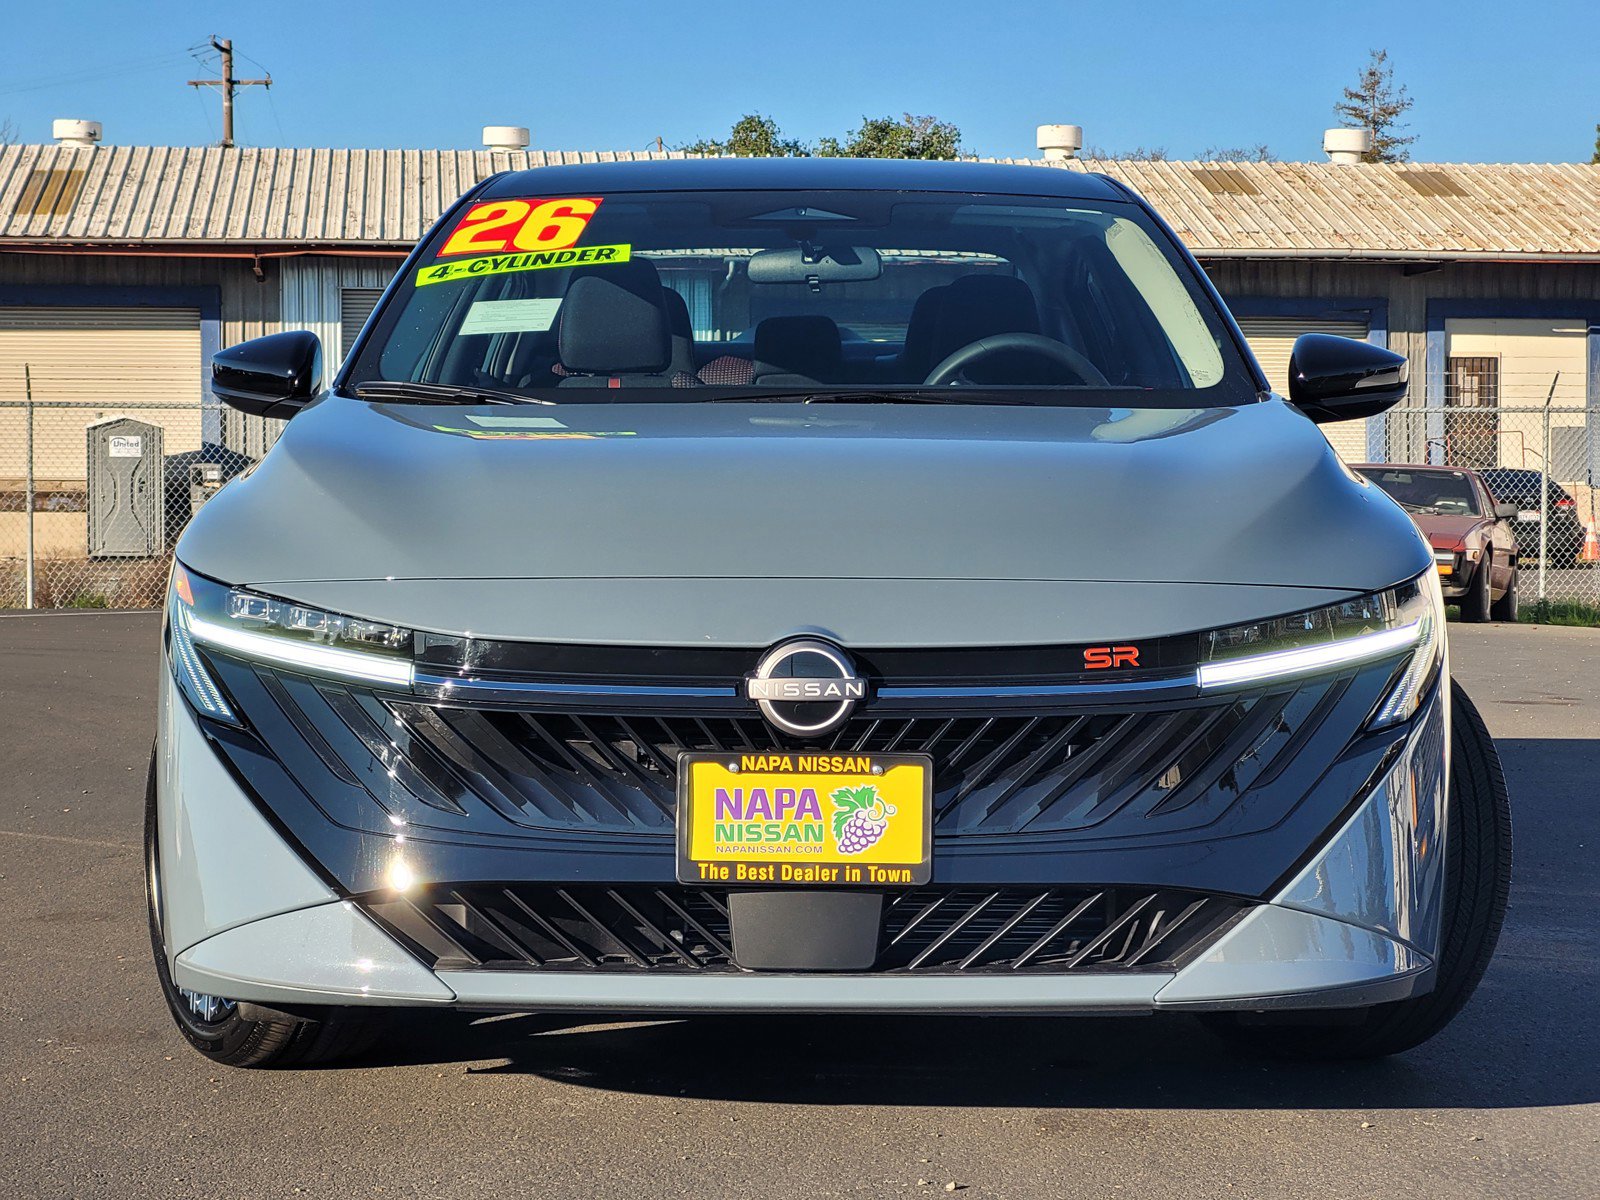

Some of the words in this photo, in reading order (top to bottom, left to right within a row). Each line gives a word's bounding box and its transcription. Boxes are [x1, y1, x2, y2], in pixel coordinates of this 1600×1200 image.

[441, 199, 597, 254] 26
[428, 247, 621, 280] 4-CYLINDER
[1083, 646, 1140, 669] SR
[752, 682, 862, 697] NISSAN
[741, 755, 793, 772] NAPA
[798, 757, 870, 773] NISSAN
[715, 788, 823, 821] NAPA
[715, 823, 823, 842] NISSAN
[716, 845, 823, 854] NAPANISSAN.COM
[698, 863, 729, 880] The
[736, 864, 774, 881] Best
[781, 865, 838, 882] Dealer
[845, 865, 861, 882] in
[868, 866, 911, 883] Town
